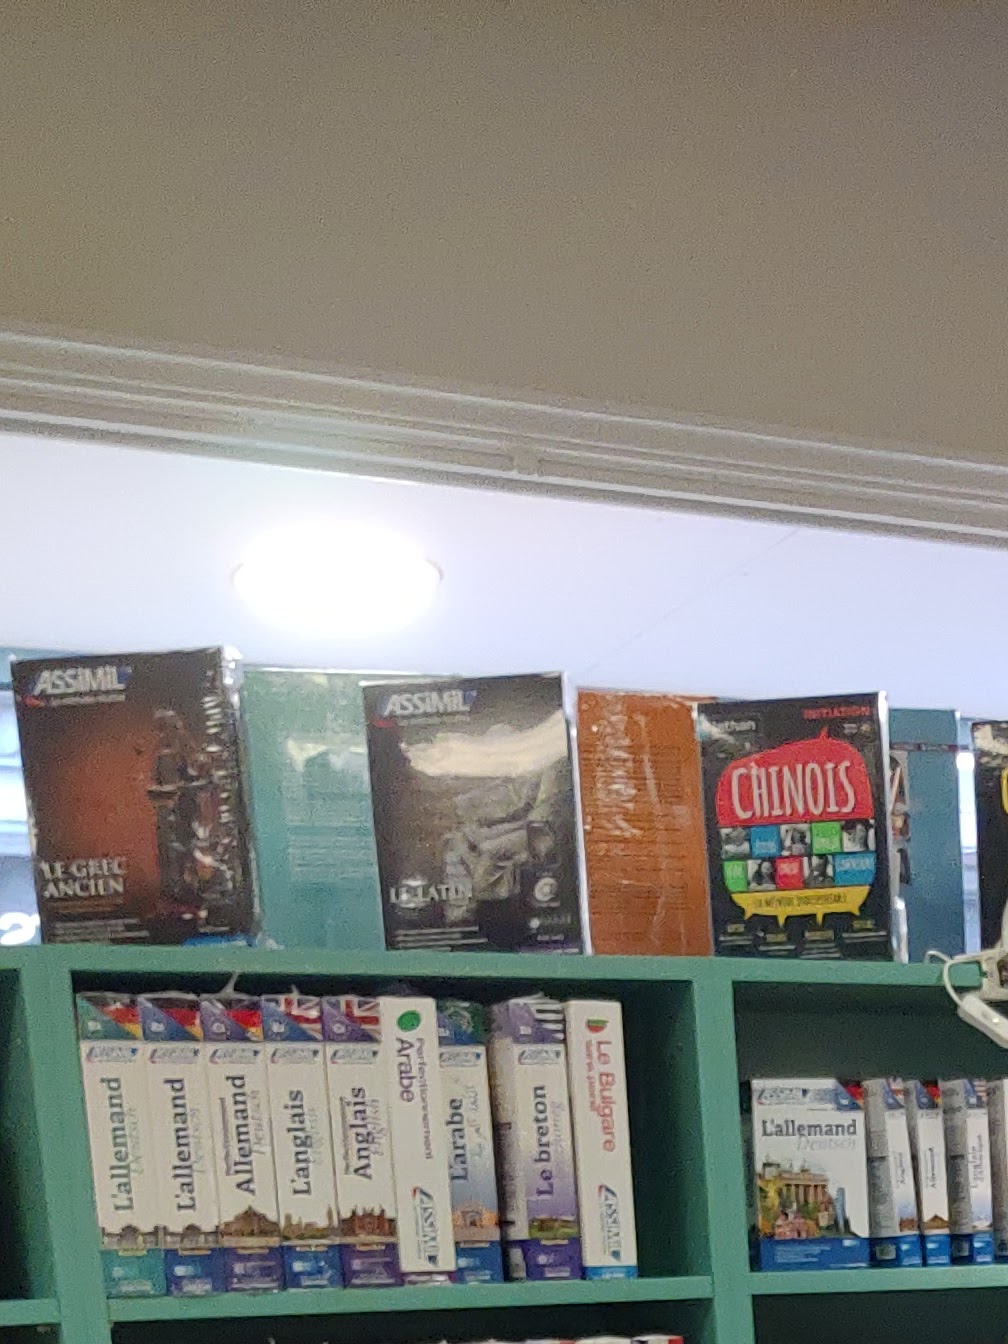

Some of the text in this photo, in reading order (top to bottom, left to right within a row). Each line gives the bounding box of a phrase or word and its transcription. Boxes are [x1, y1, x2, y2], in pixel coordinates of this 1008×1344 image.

[730, 760, 856, 820] CHINOIS
[395, 1037, 415, 1103] Arabe
[597, 1039, 617, 1152] Le Bulgare
[100, 1075, 134, 1213] L'allemand
[164, 1077, 197, 1213] L'allemand
[225, 1074, 256, 1196] Allemand
[284, 1089, 312, 1196] L'anglais
[350, 1086, 373, 1181] Anglais
[445, 1098, 469, 1182] L'arabe
[532, 1084, 554, 1197] Le breton
[761, 1118, 857, 1137] L'allemand
